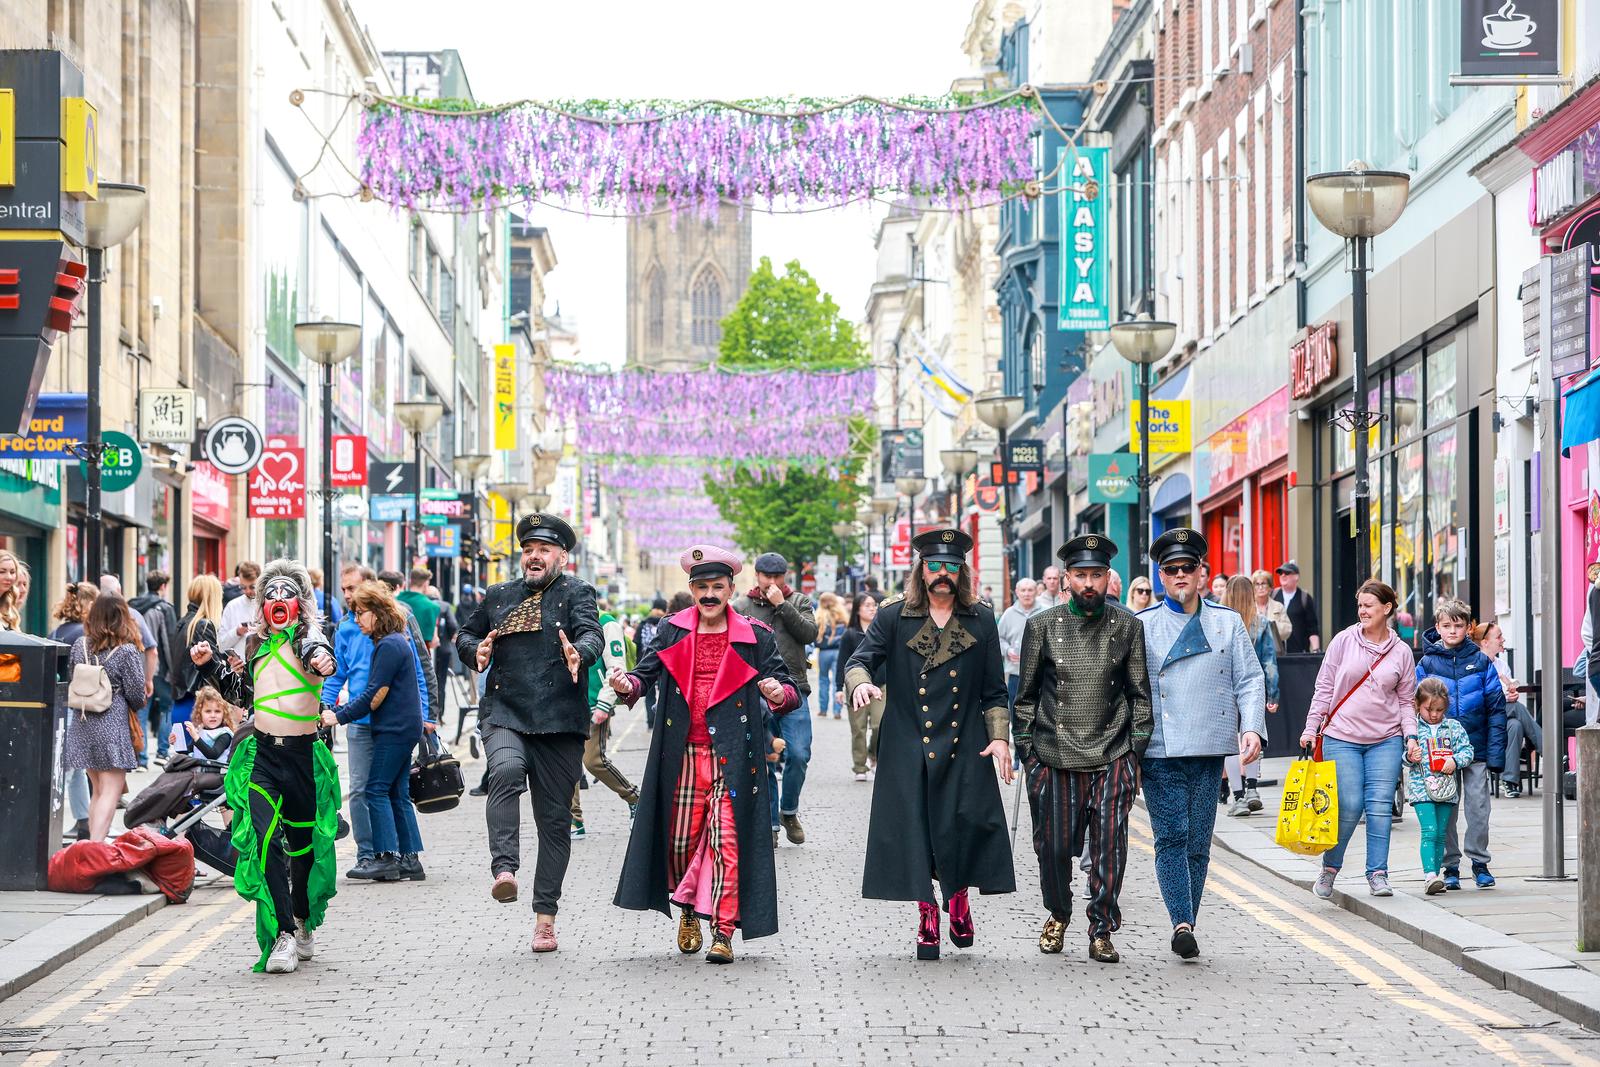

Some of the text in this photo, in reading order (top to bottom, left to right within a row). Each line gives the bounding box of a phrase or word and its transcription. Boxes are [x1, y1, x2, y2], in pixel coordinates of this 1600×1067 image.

[1072, 156, 1095, 303] AKASYA
[30, 416, 64, 432] ard
[148, 429, 187, 438] SUSHI
[1013, 446, 1038, 455] MOSS
